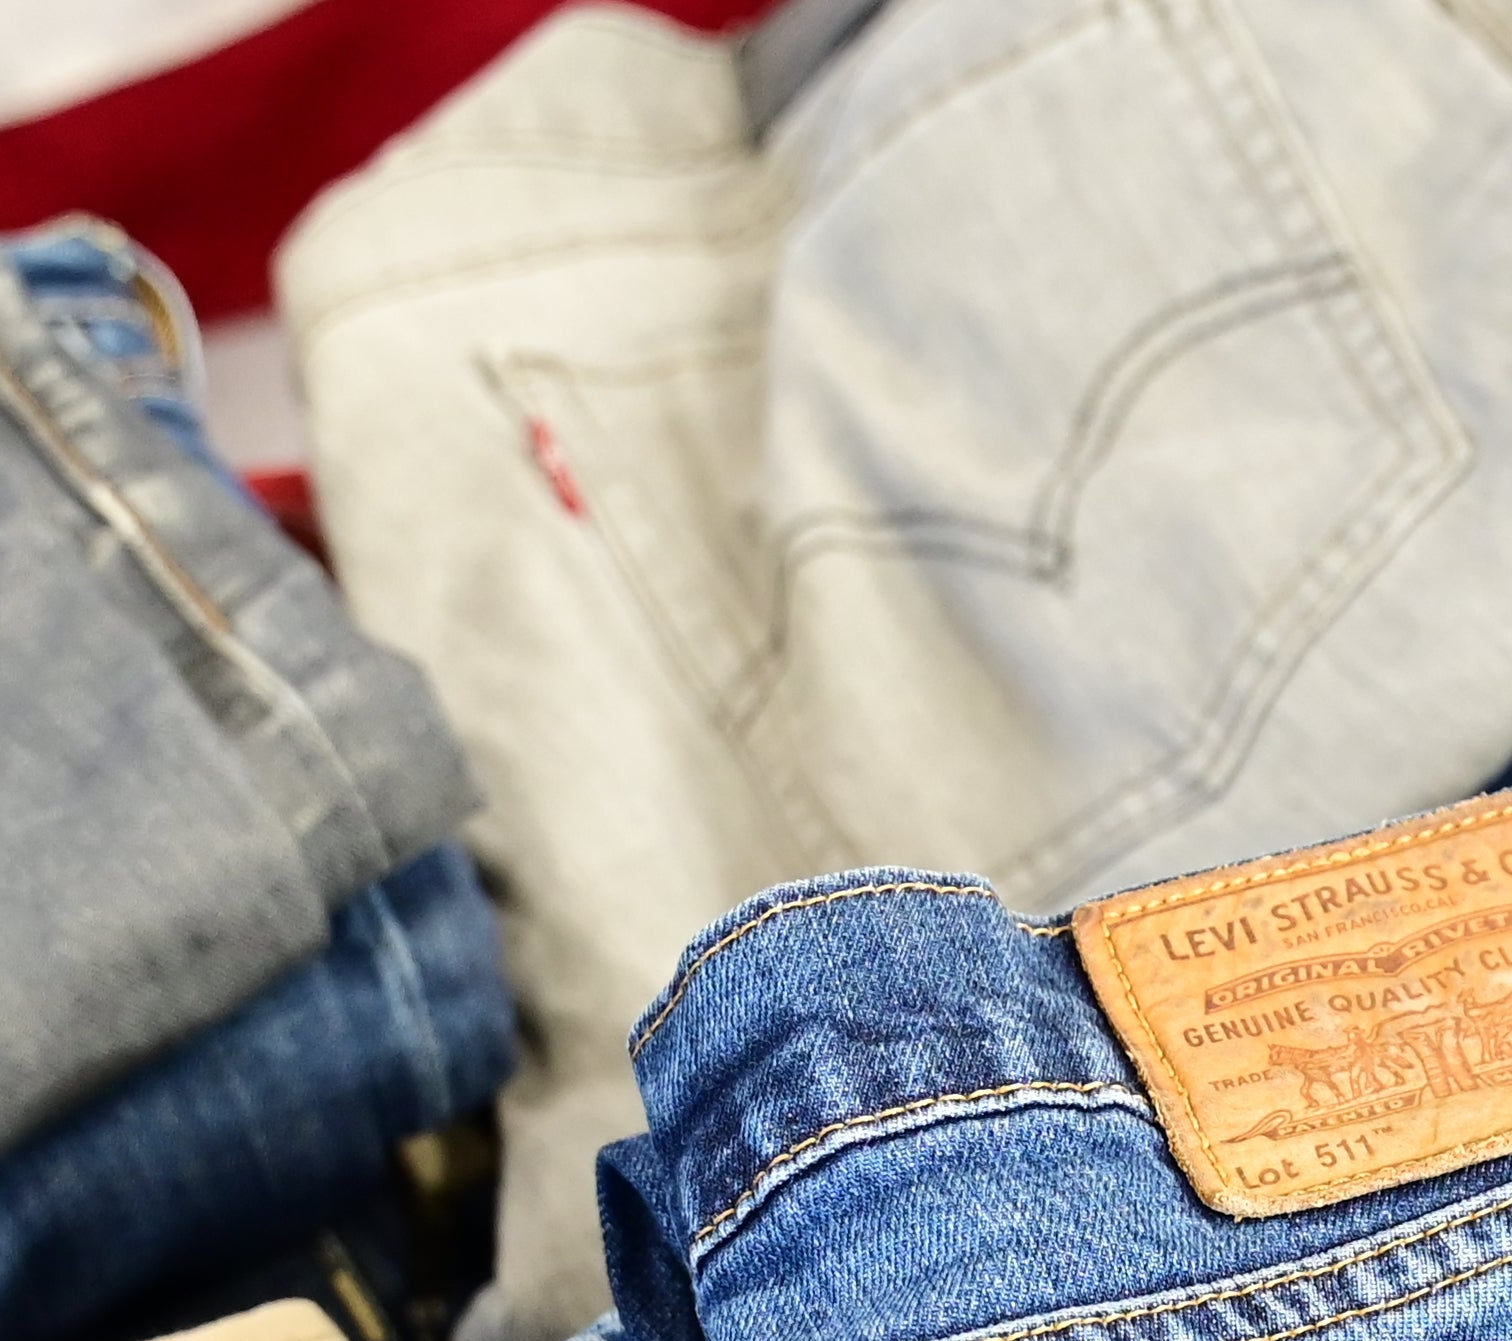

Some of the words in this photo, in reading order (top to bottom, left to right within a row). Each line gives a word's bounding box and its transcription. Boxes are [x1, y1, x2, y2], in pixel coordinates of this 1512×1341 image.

[1159, 916, 1257, 962] LEVI
[1269, 863, 1449, 932] STRAUSS
[1461, 858, 1490, 885] &
[1280, 930, 1319, 949] SAN
[1181, 999, 1315, 1048] GENUINE
[1327, 955, 1466, 1016] QUALITY
[1210, 957, 1385, 1007] ORIGINAL
[1208, 1068, 1275, 1092] TRADE
[1235, 1157, 1300, 1189] Lot
